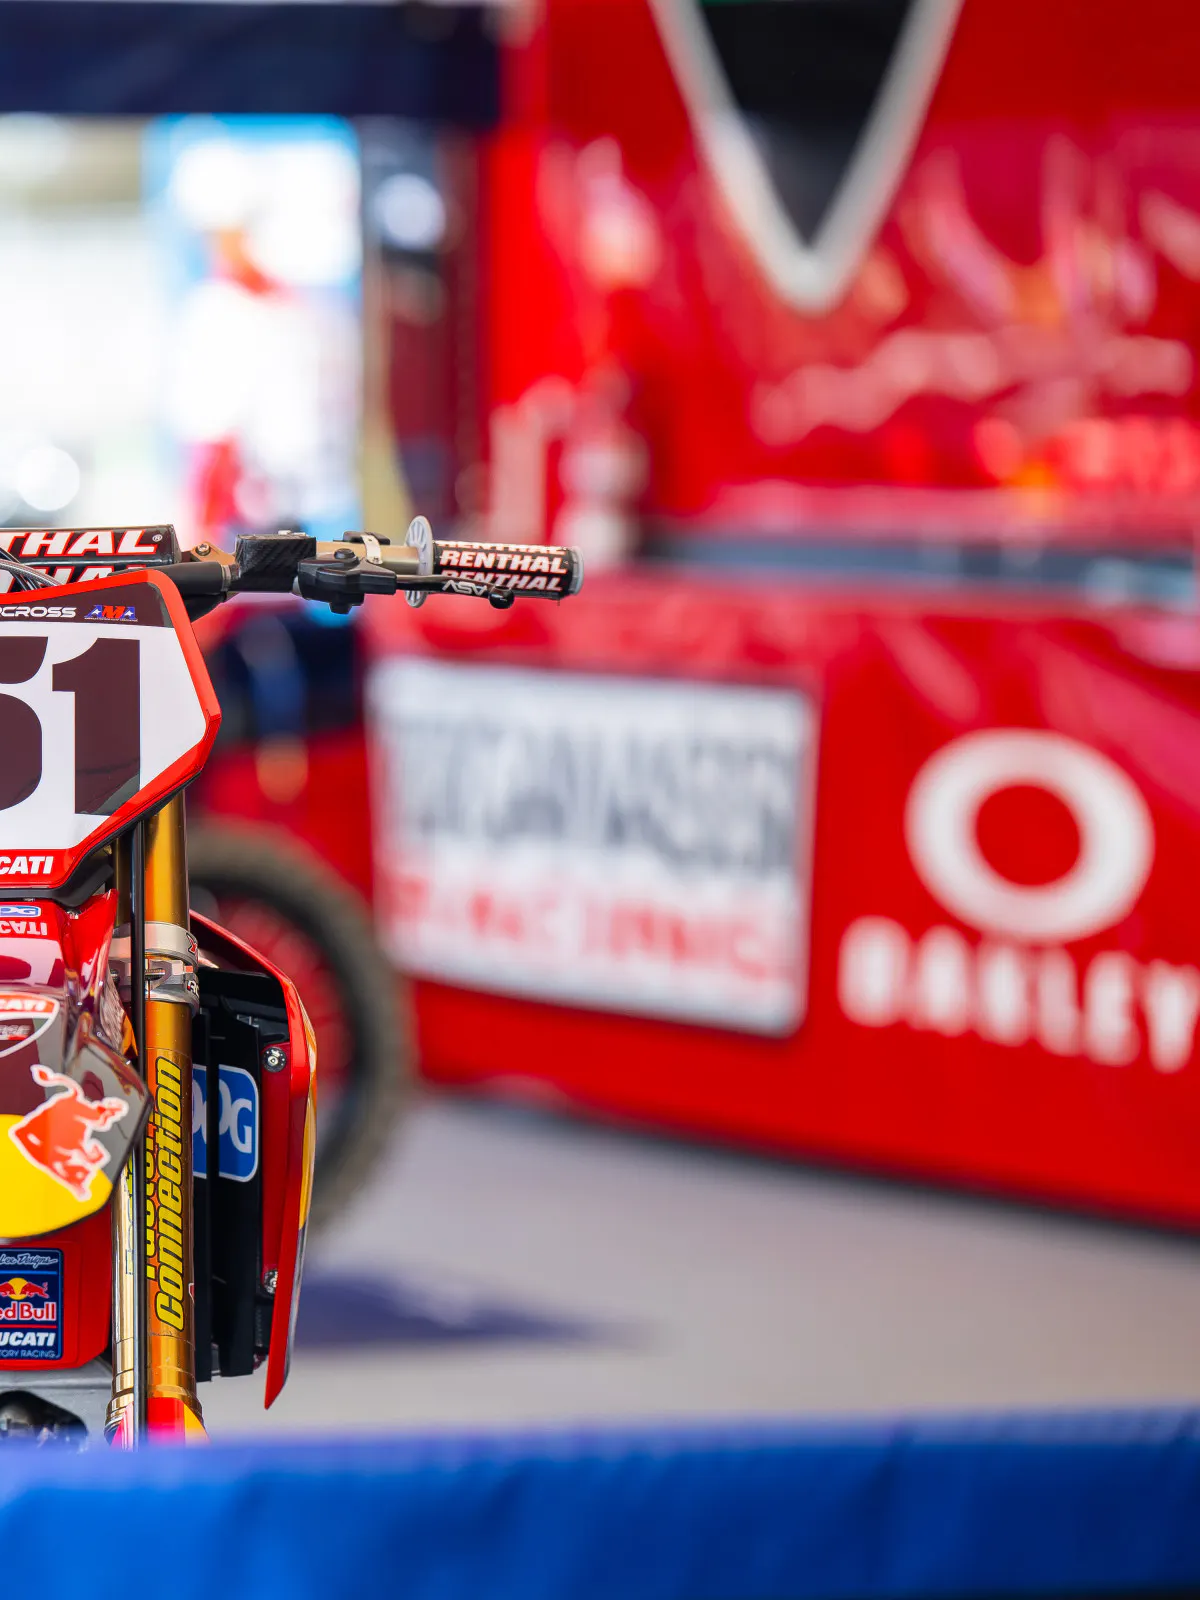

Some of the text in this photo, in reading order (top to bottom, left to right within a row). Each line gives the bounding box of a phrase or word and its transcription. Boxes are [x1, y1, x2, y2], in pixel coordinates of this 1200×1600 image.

[440, 550, 568, 574] RENTHAL
[84, 605, 137, 619] AMA
[155, 1056, 184, 1332] connection
[18, 1301, 57, 1321] Bull
[20, 1349, 56, 1359] RACING
